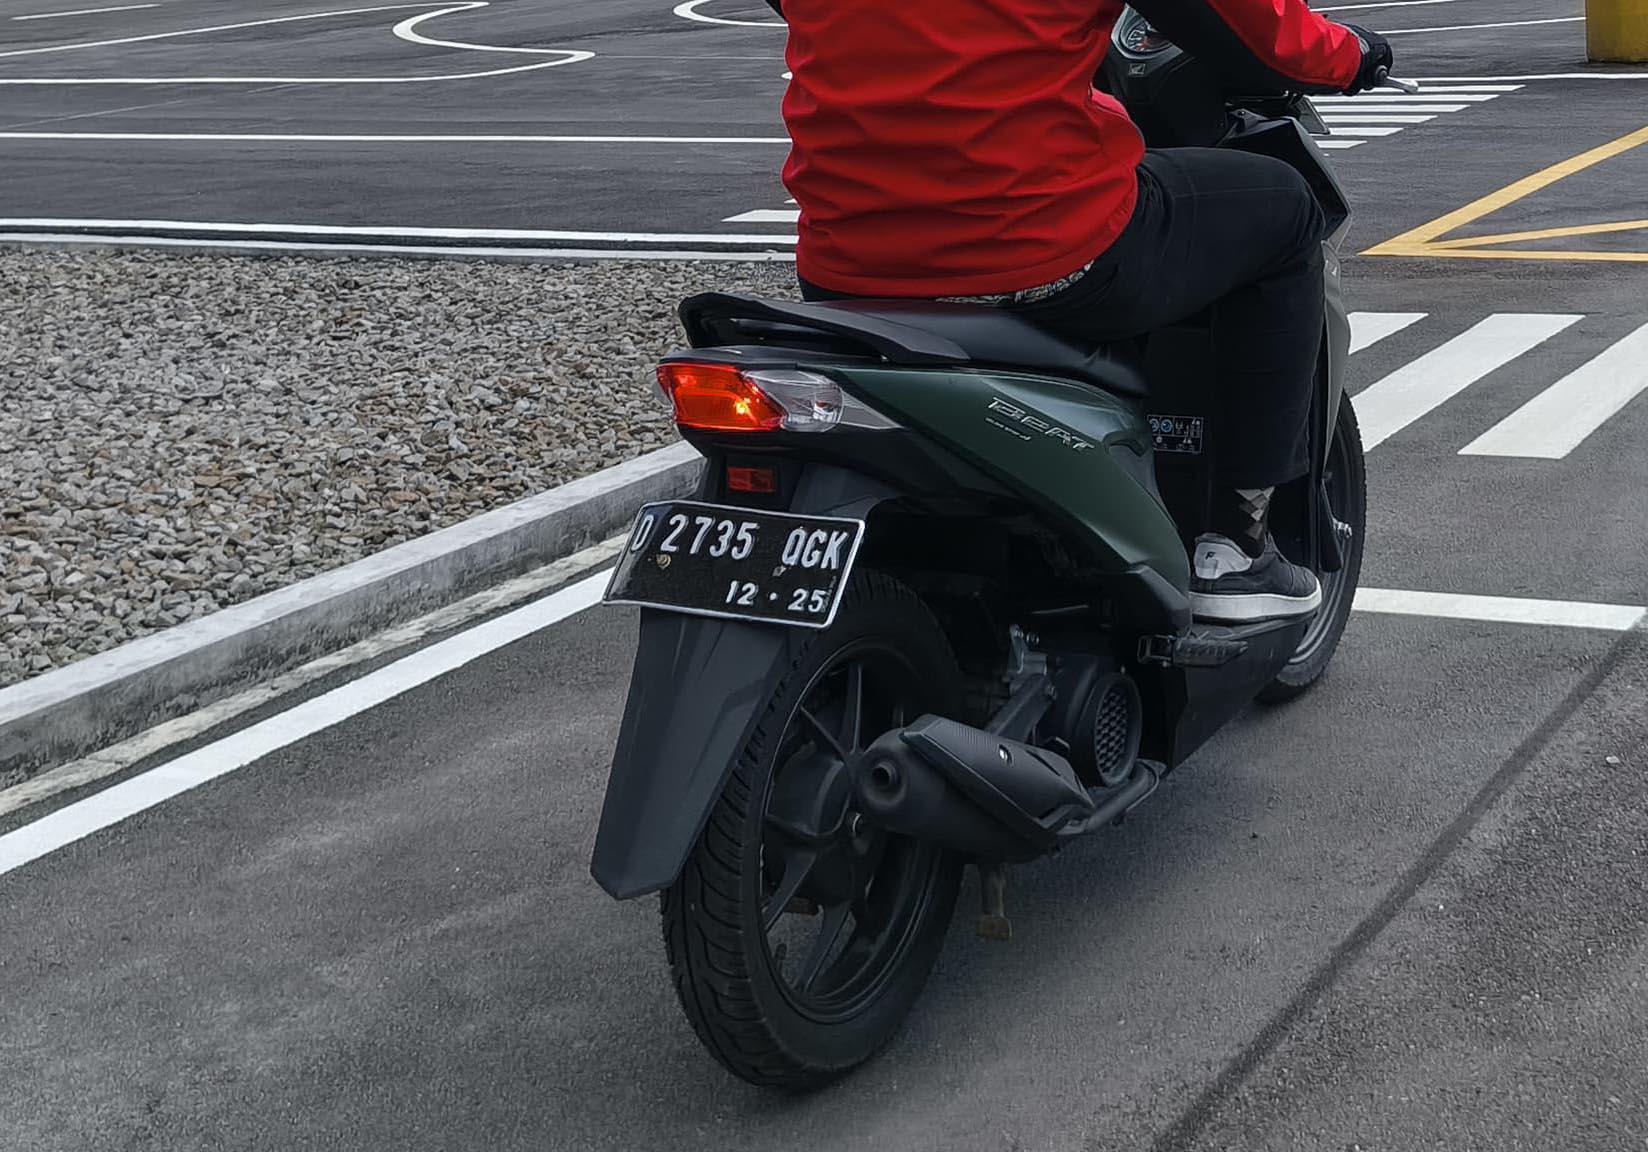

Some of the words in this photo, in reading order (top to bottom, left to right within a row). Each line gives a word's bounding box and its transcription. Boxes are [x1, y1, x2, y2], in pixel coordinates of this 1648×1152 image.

[630, 513, 654, 552] D
[660, 513, 759, 560] 2735
[725, 580, 758, 606] 12
[787, 588, 828, 613] 25
